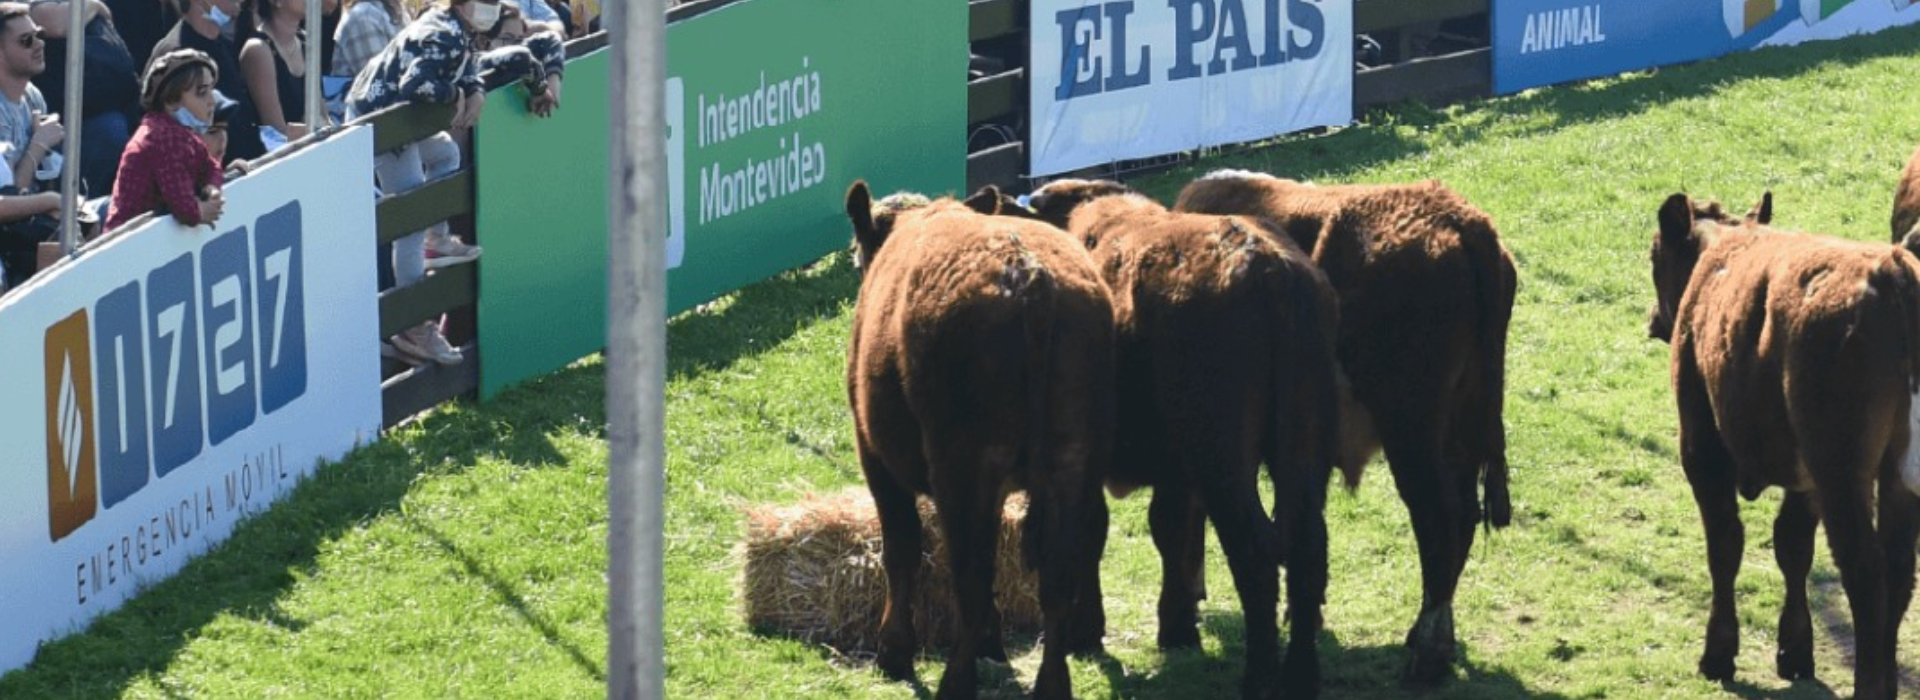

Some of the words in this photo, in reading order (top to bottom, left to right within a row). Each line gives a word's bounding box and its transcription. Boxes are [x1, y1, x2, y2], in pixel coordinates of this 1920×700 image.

[1055, 0, 1151, 101] EL
[1520, 4, 1605, 54] ANIMAL
[698, 57, 821, 147] Intendencia
[700, 133, 825, 225] Montevideo
[114, 246, 292, 454] 1727
[76, 486, 215, 605] EMERGENCIA
[225, 442, 287, 512] MÓVIL
